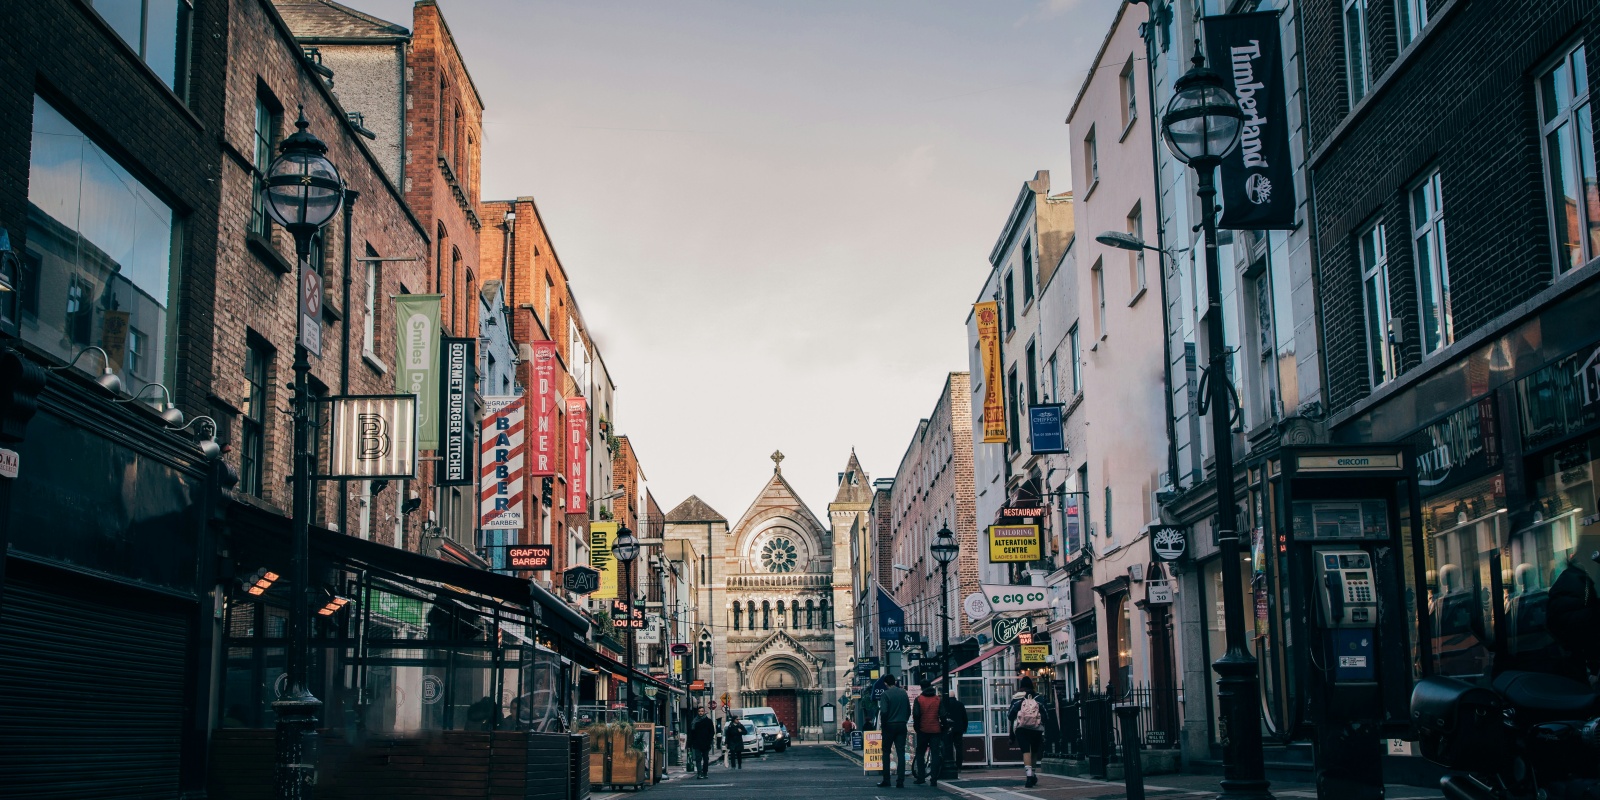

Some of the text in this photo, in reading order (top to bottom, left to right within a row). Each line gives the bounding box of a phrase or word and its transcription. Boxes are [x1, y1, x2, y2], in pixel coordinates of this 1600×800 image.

[1230, 40, 1269, 169] Timberland
[412, 321, 425, 365] Smiles
[449, 343, 464, 480] GOURMET BURGER KITCHEN
[538, 378, 549, 471] DINER
[357, 413, 391, 460] B
[495, 417, 511, 511] BARBER
[572, 429, 581, 509] DINER
[1003, 507, 1042, 517] RESTAURANT
[994, 538, 1037, 546] ALTERATIONS
[1003, 546, 1028, 554] CENTRE
[509, 548, 550, 557] GRAFTON
[512, 557, 547, 566] BARBER
[565, 571, 597, 590] EAT
[992, 592, 1044, 605] e cig co
[886, 639, 901, 651] 22
